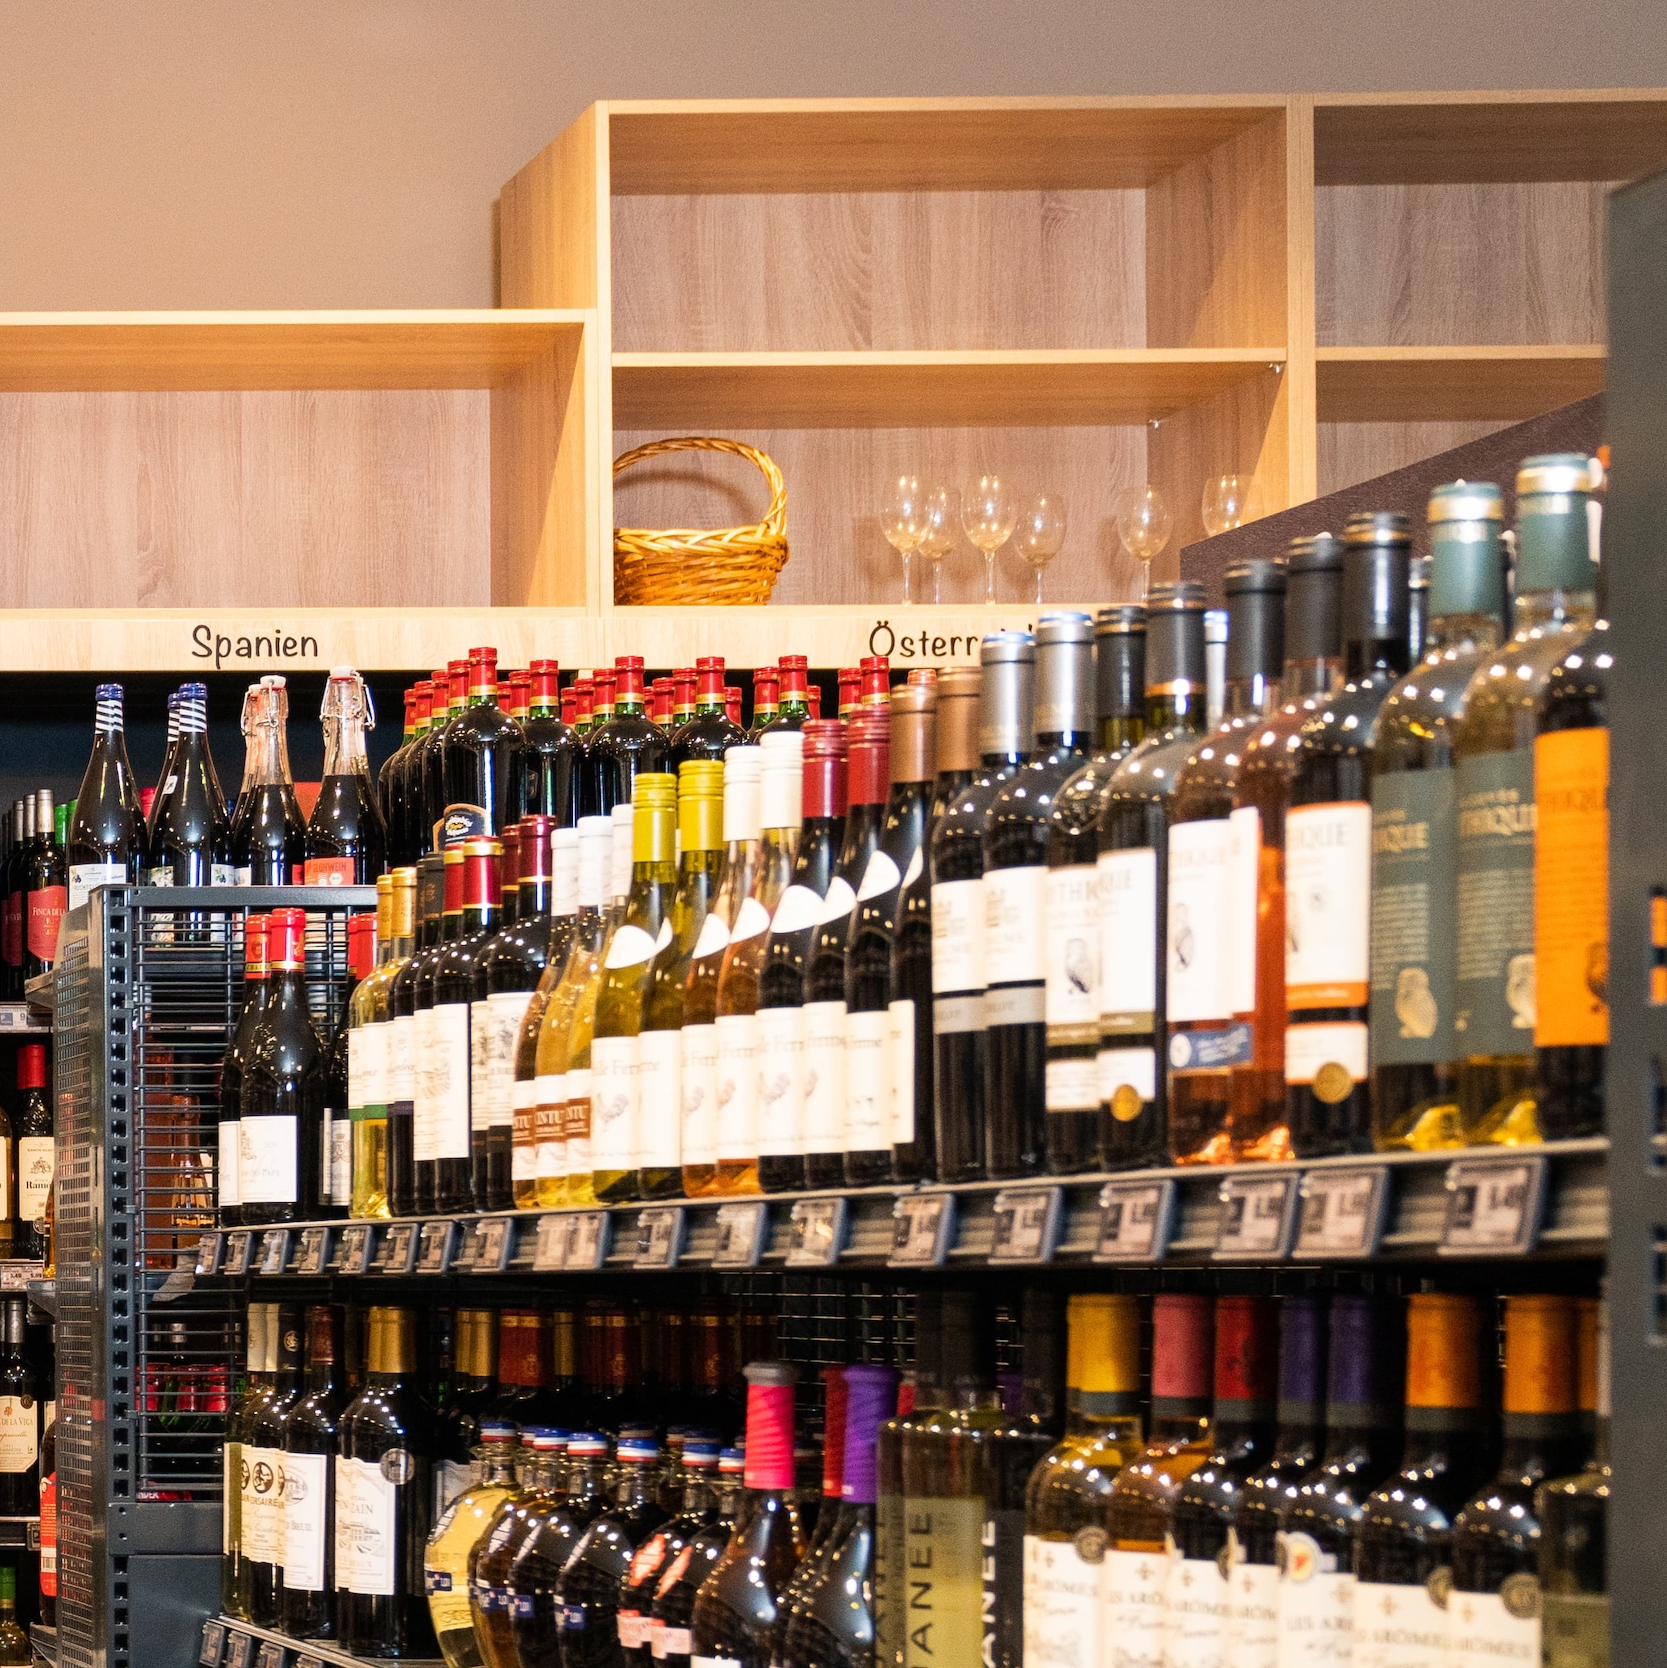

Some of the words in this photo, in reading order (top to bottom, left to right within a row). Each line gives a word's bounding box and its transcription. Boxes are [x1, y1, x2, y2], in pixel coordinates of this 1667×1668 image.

[190, 624, 320, 669] Spanien
[868, 619, 1033, 659] Österr
[33, 906, 51, 916] FINCA
